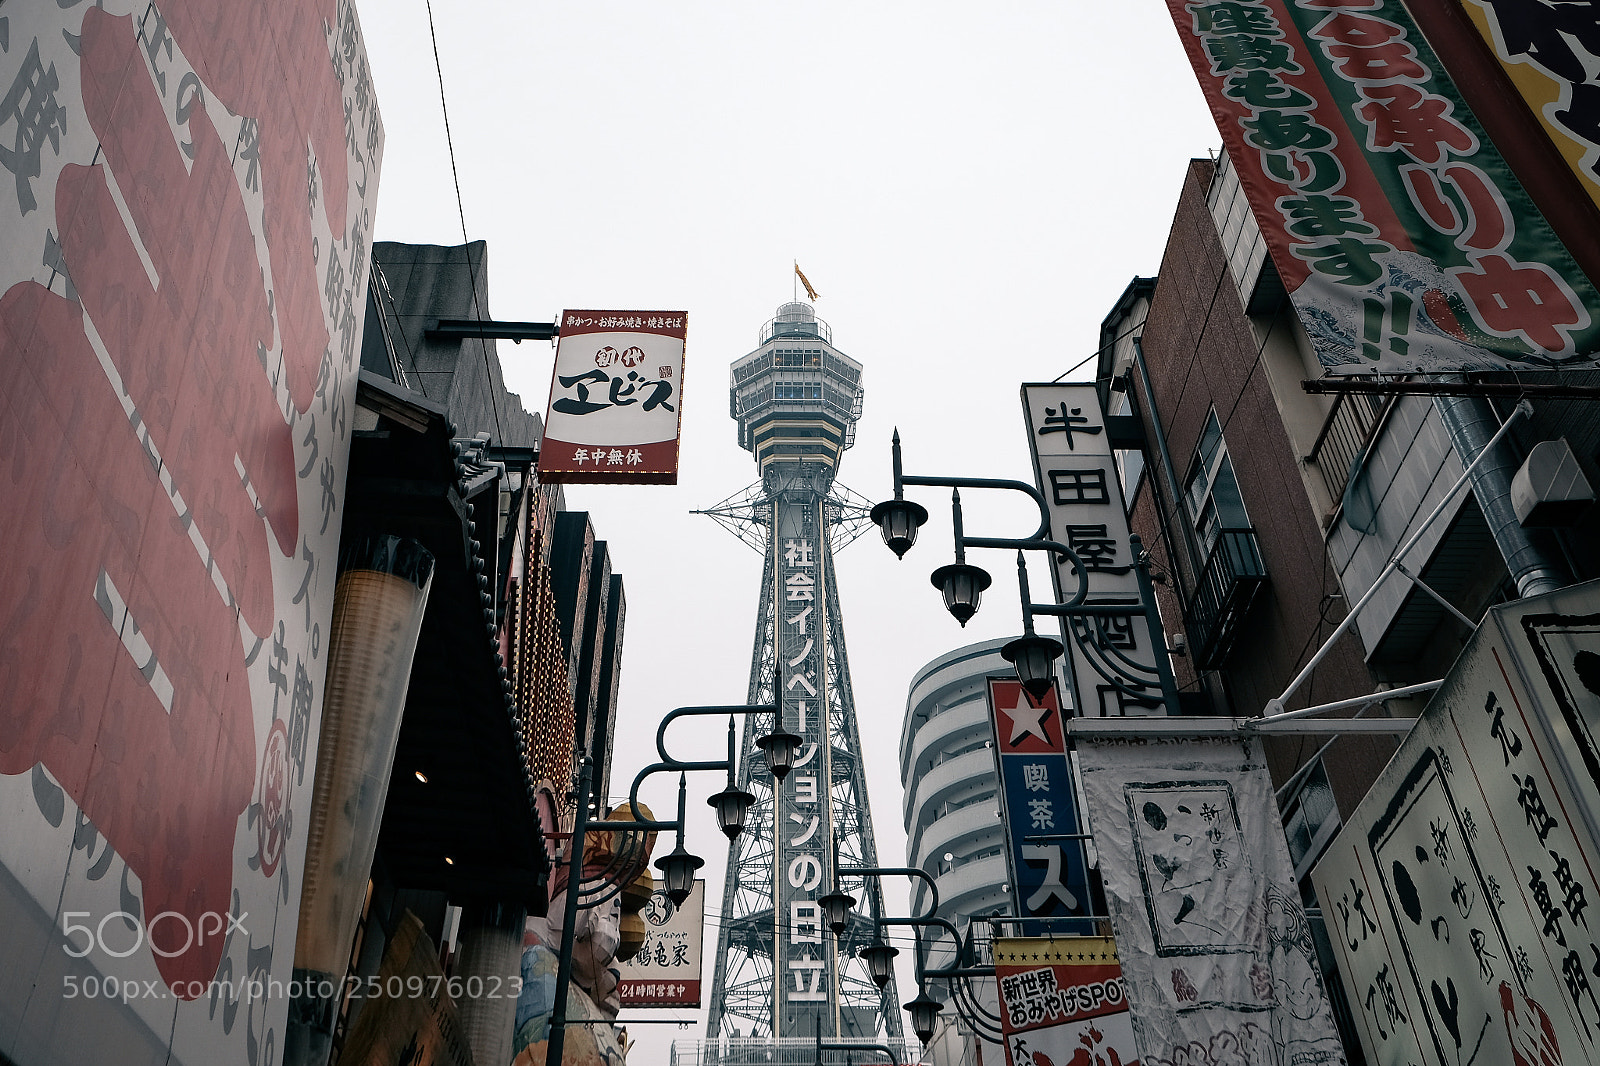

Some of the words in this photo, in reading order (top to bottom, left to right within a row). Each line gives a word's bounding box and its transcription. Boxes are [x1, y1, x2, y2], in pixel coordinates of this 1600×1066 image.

[567, 315, 682, 329] 串かつ・お好み焼き・焼きそば
[572, 448, 643, 466] 年中無休
[1023, 763, 1055, 830] 喫茶
[1199, 802, 1230, 871] 新世界
[1021, 844, 1081, 937] ス
[621, 984, 686, 998] 24時間営業中
[1002, 968, 1056, 1003] 新世界
